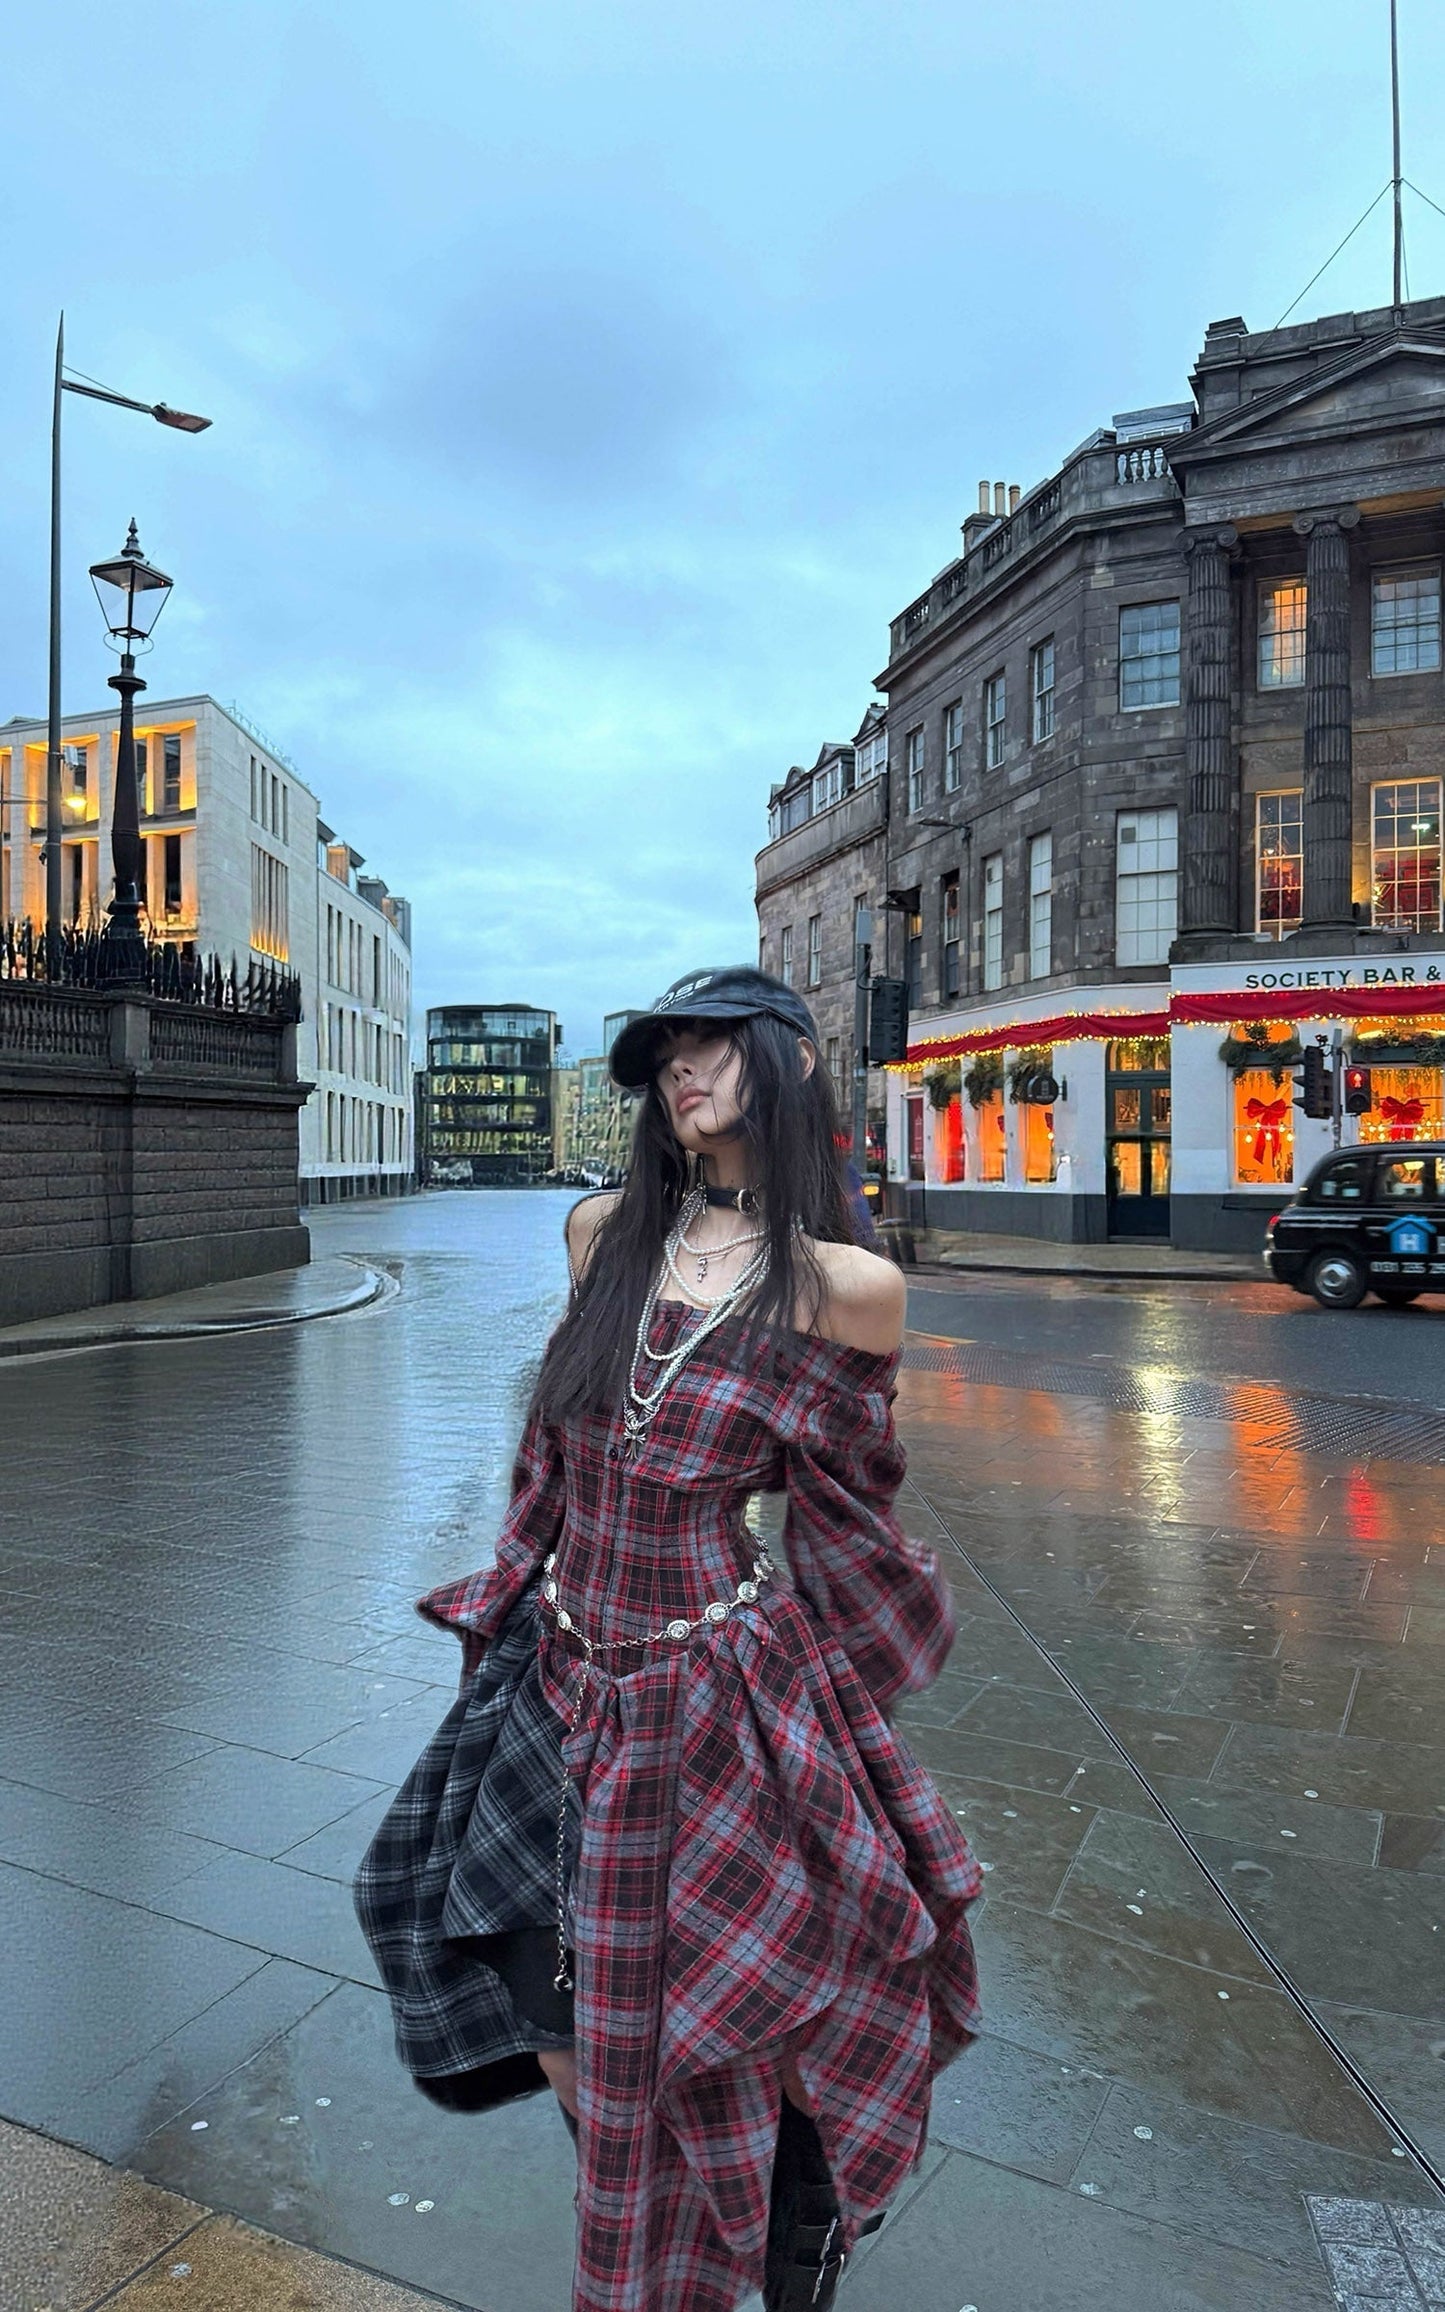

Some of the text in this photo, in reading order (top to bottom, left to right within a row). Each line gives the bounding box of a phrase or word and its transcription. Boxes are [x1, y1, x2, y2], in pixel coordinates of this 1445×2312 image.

[1246, 965, 1441, 989] SOCIETY BAR &
[656, 975, 713, 1010] OSE
